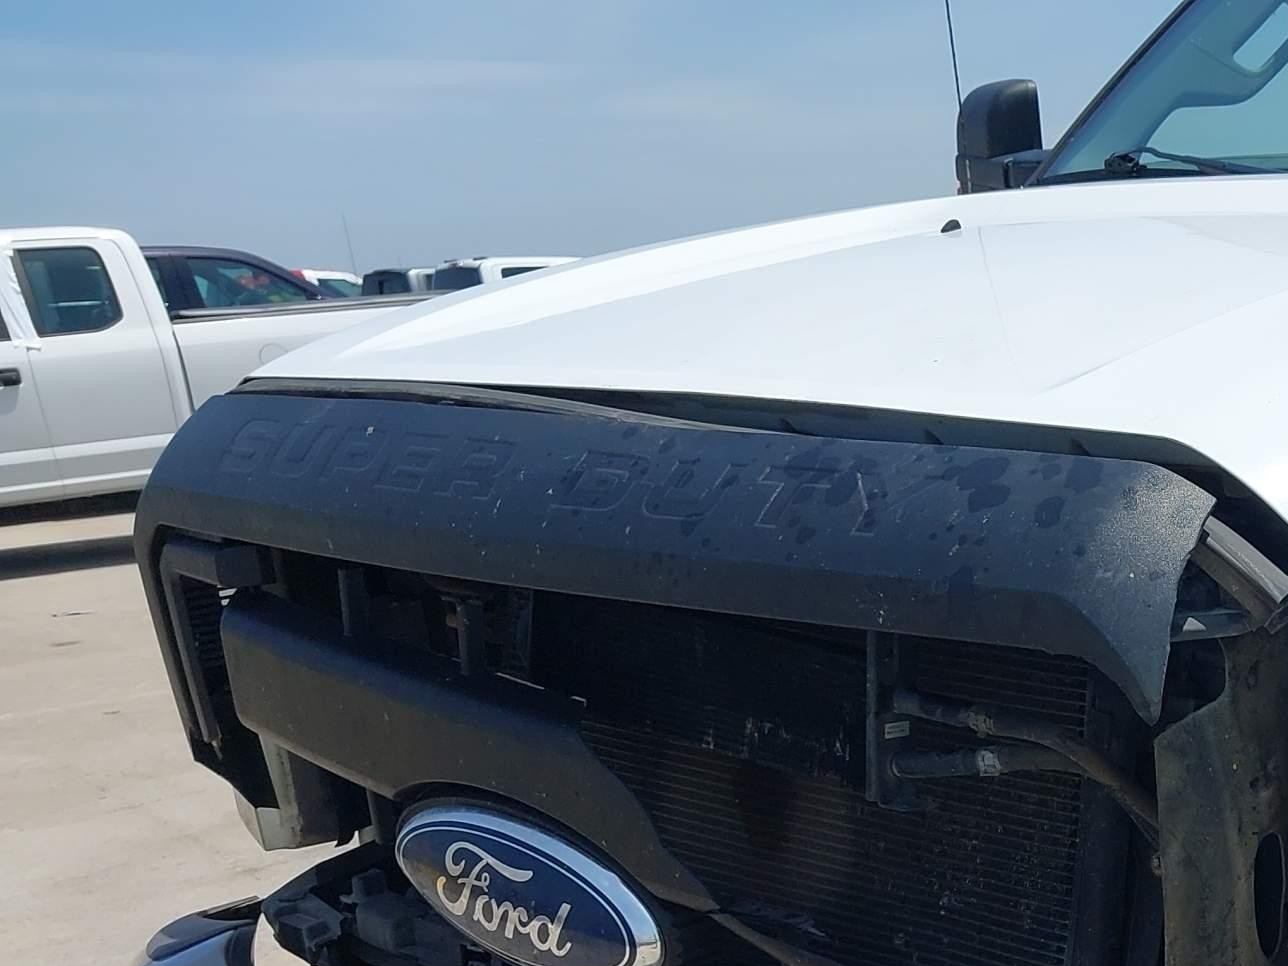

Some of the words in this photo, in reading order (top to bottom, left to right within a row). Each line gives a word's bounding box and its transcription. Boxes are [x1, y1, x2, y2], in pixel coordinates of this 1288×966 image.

[219, 416, 517, 500] SUPER
[550, 447, 945, 538] DUTY
[436, 841, 573, 957] Ford
